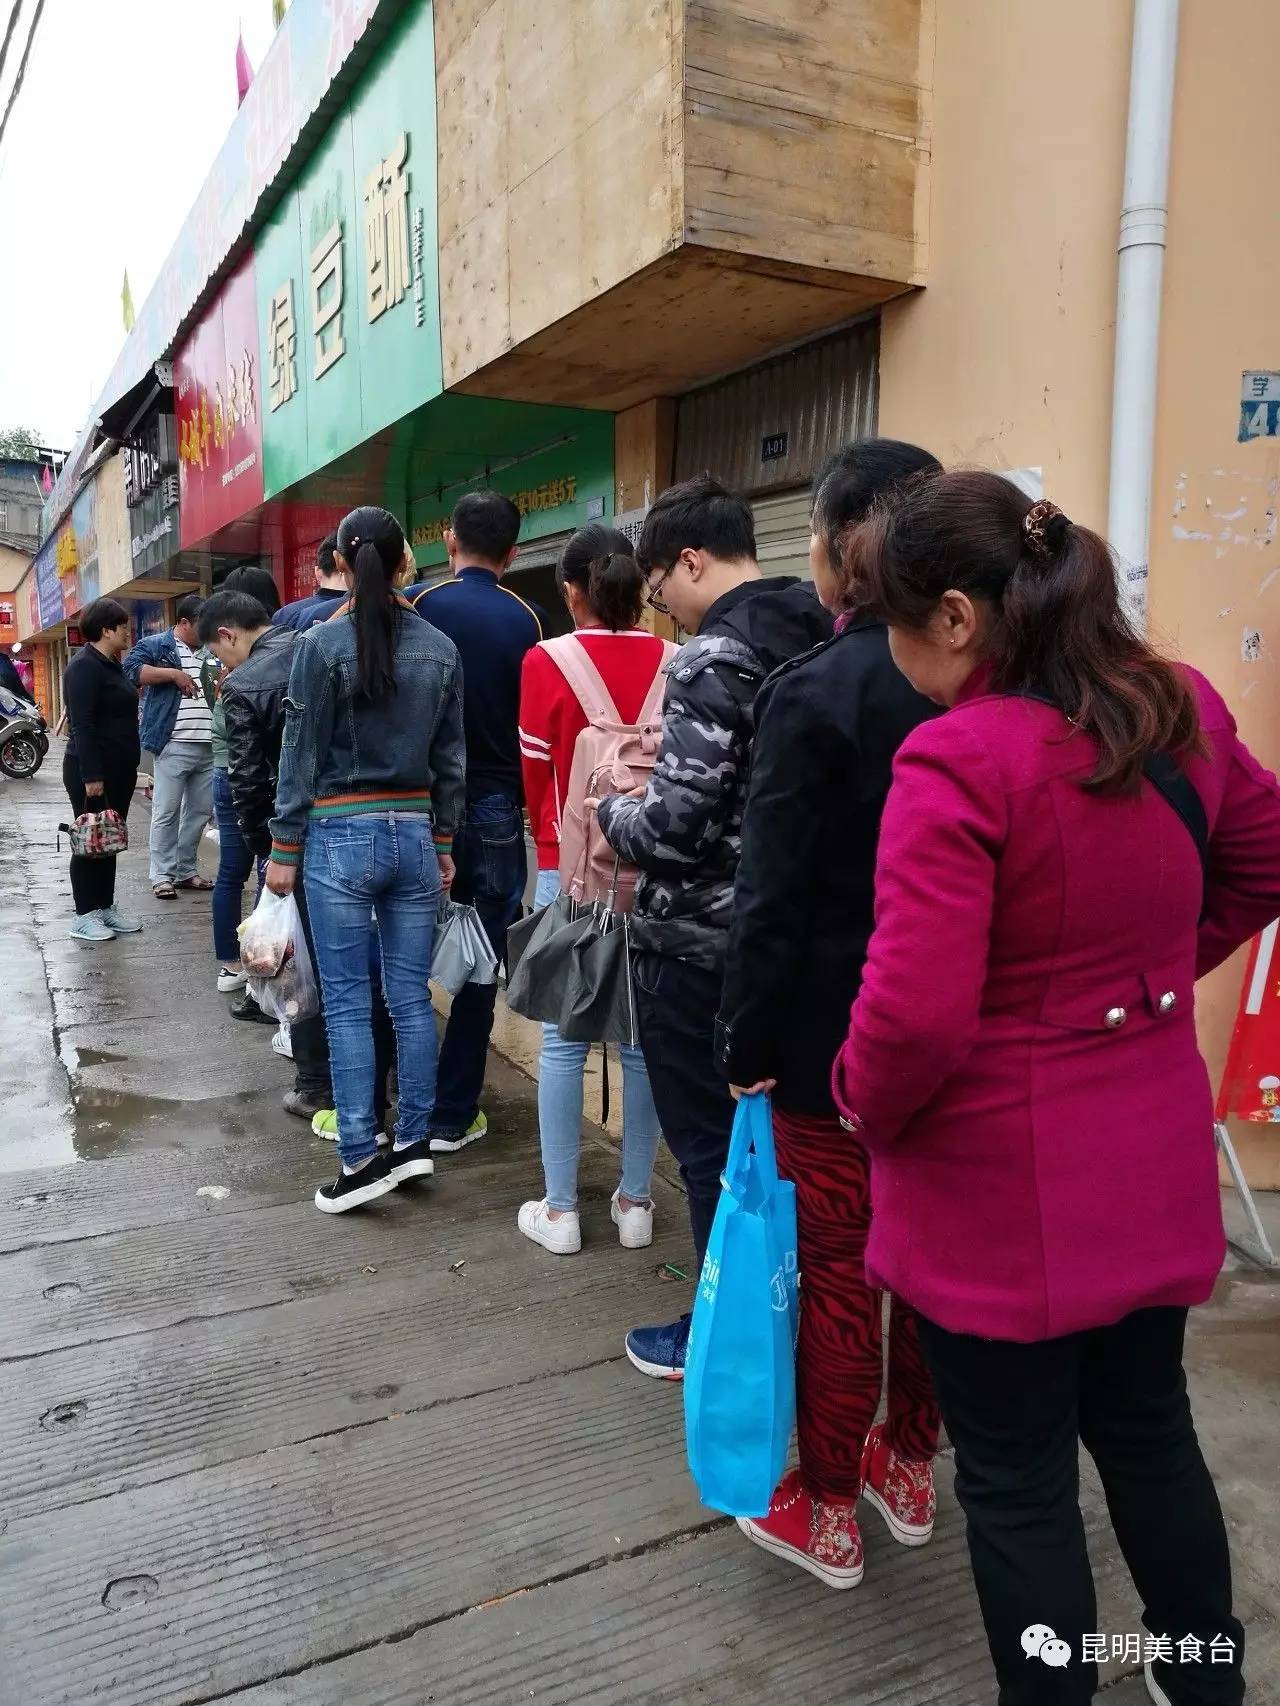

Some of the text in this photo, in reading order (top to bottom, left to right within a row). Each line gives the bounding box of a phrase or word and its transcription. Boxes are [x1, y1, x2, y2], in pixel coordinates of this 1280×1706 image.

[269, 130, 411, 413] 绿豆酥
[1251, 376, 1270, 397] 学
[1247, 401, 1280, 437] 4
